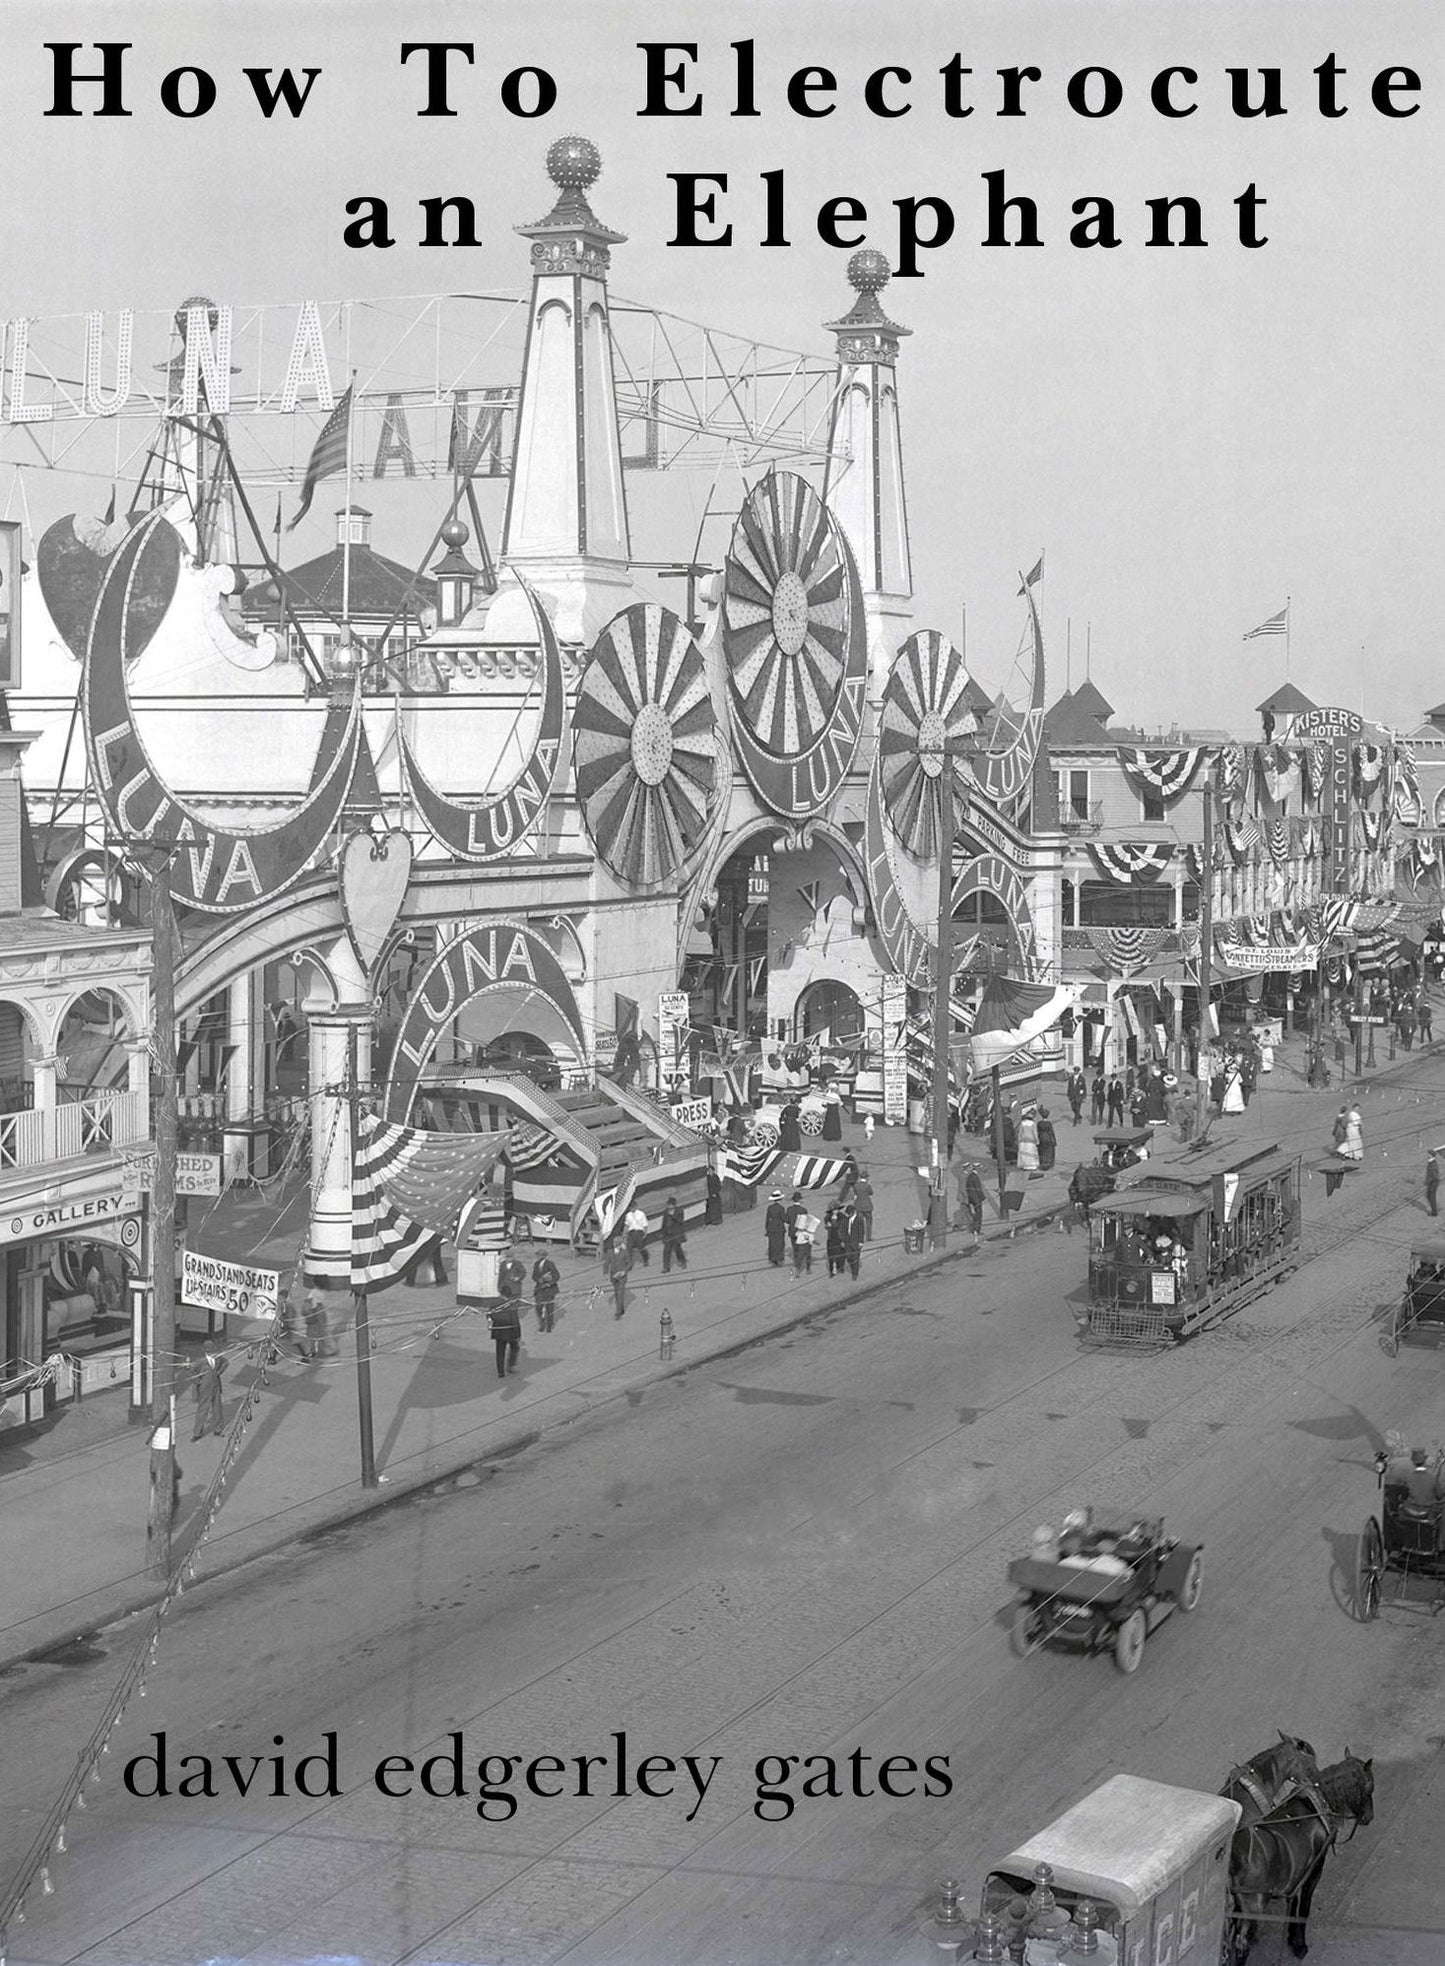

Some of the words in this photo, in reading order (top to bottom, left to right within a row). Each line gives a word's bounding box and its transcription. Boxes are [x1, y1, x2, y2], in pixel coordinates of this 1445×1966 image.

[9, 299, 335, 423] LUNA
[792, 676, 865, 811] LUNA
[986, 708, 1043, 795] LUNA
[1295, 709, 1361, 735] KISTER'S
[1310, 724, 1348, 737] HOTEL
[94, 720, 263, 902] LUNA
[468, 738, 559, 853] LUNA
[1334, 748, 1348, 883] SCHLITZ
[977, 815, 1007, 850] PARKING
[1012, 847, 1030, 865] FREE
[977, 857, 1032, 956] LUNA
[401, 930, 537, 1067] LUNA
[661, 994, 686, 1003] LUNA
[676, 1102, 708, 1124] PRESS
[33, 1194, 123, 1228] GALLERY
[186, 1278, 227, 1301] UPSTAIRS
[245, 1270, 276, 1292] SEATS
